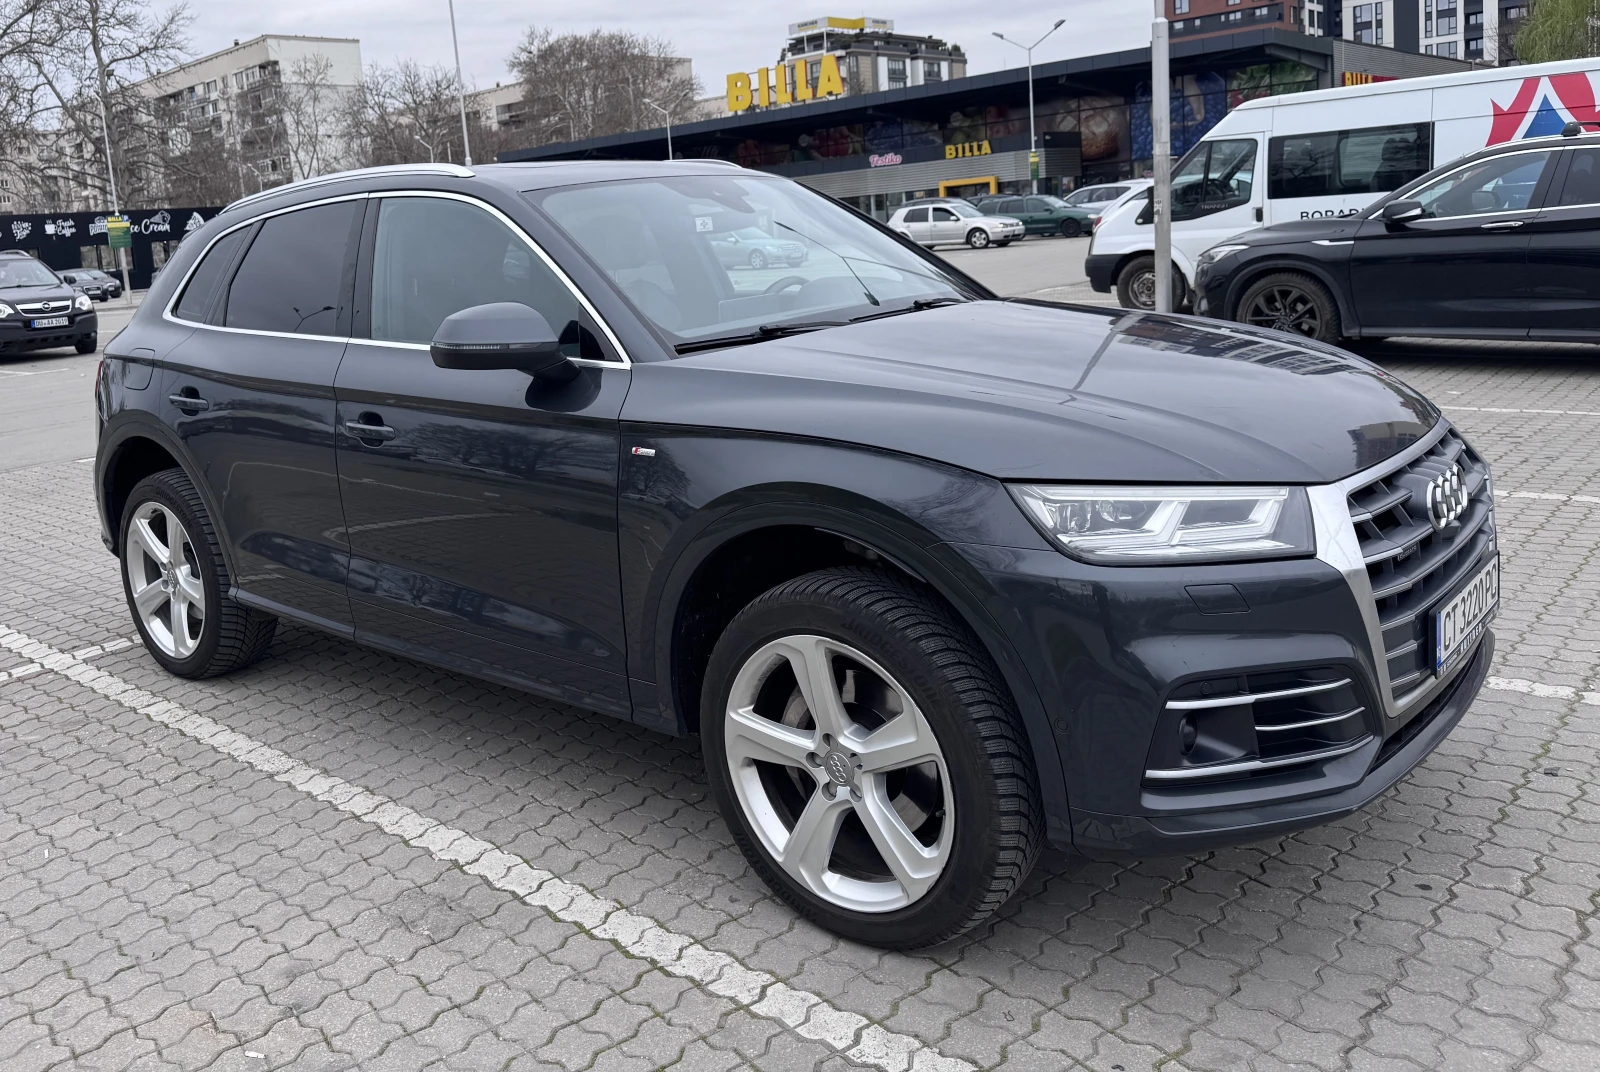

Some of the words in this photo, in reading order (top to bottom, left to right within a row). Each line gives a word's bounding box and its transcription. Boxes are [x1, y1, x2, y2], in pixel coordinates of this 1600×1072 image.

[726, 54, 845, 112] BILLA
[945, 139, 992, 160] BILLA
[56, 218, 75, 229] Fresh
[57, 226, 77, 238] Coffee
[141, 218, 171, 235] Cream
[1443, 602, 1458, 652] CT
[1459, 576, 1484, 635] 3220
[1485, 563, 1497, 608] PC
